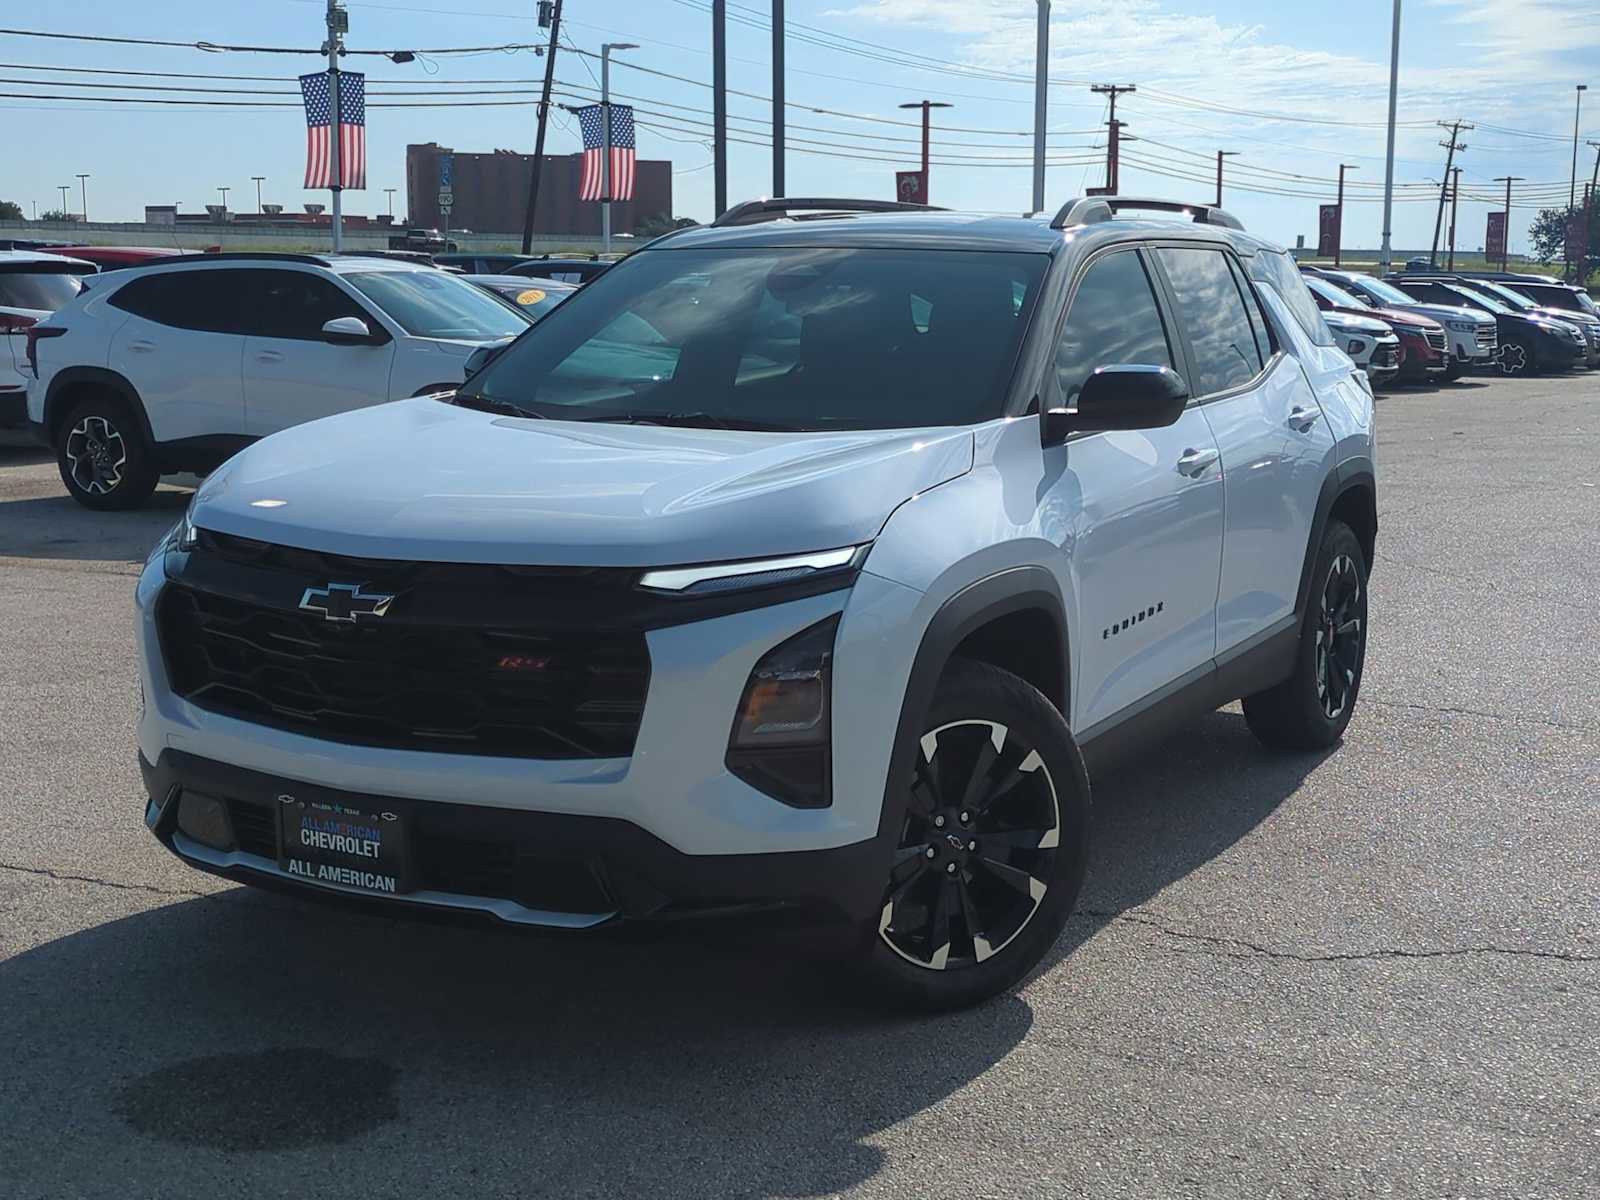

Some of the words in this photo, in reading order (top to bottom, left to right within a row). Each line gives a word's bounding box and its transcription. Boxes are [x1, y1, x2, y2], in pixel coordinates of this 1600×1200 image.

[1103, 601, 1163, 640] EQUINOX
[301, 816, 321, 831] ALL
[322, 820, 380, 841] AMERICAN
[301, 828, 380, 858] CHEVROLET
[288, 859, 315, 877] ALL
[318, 865, 396, 892] AMERICAN
